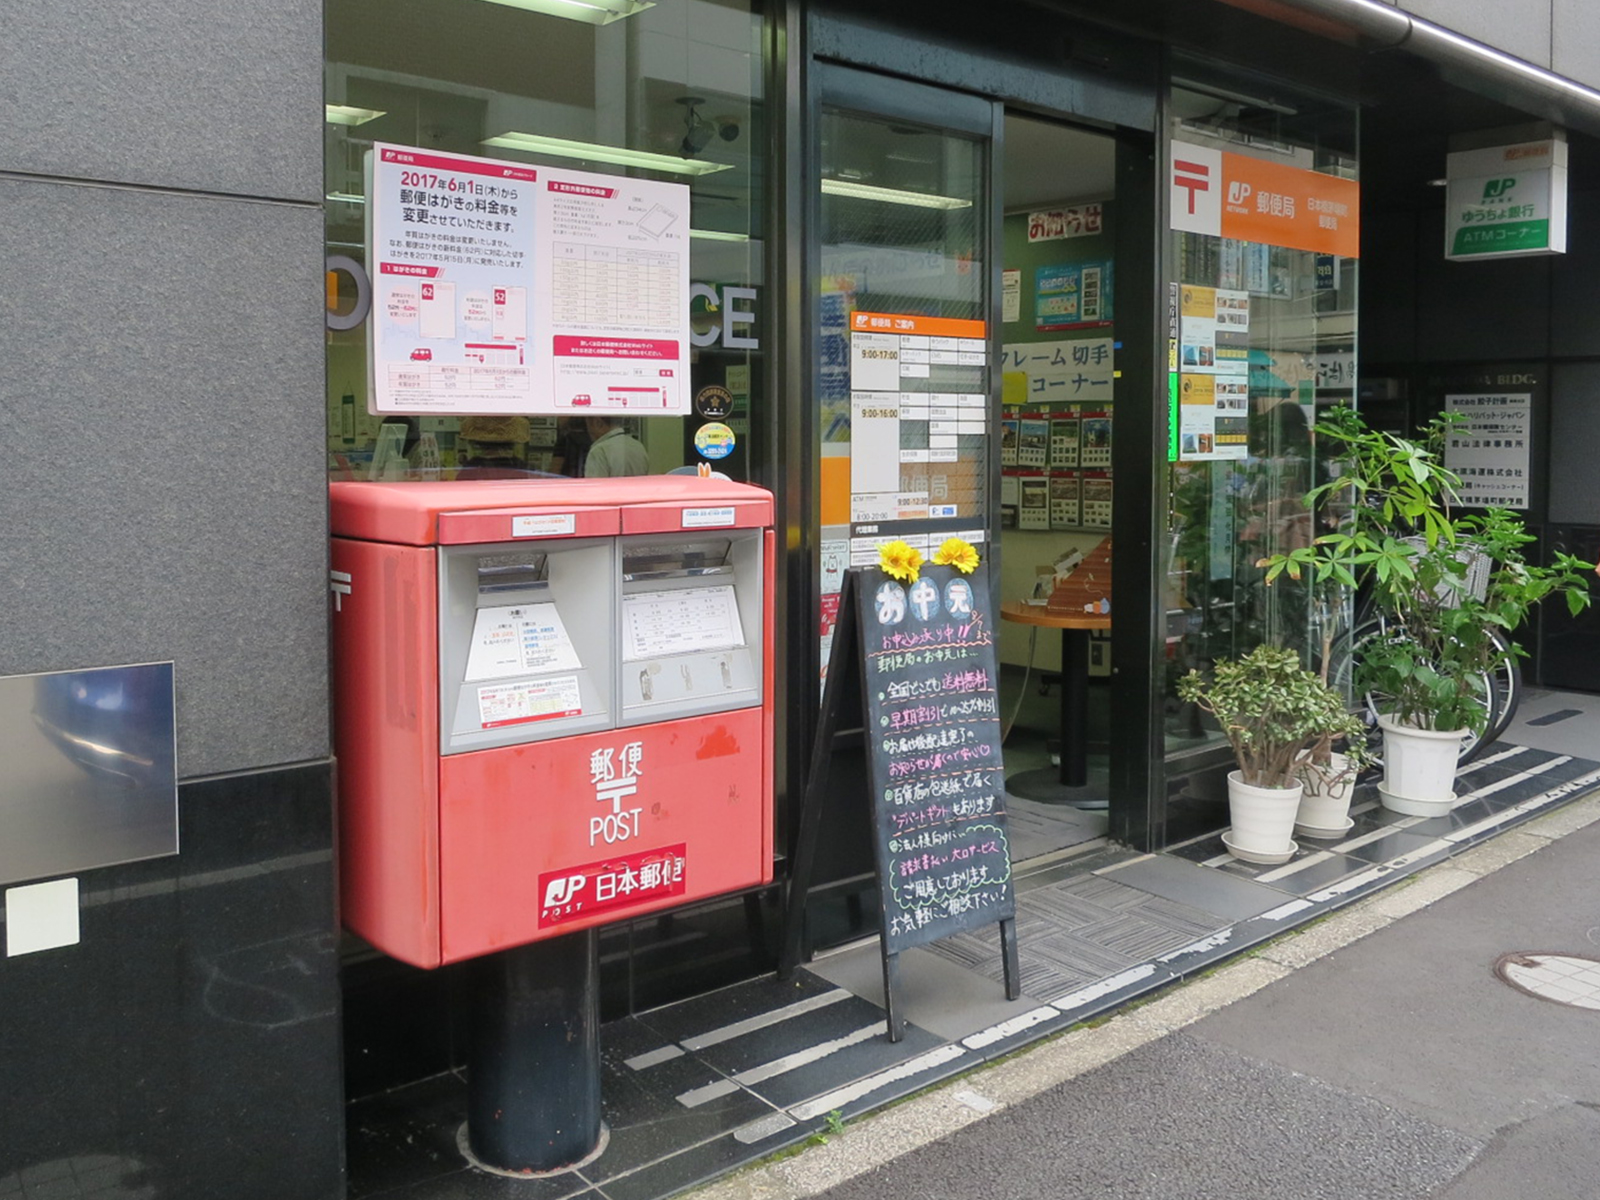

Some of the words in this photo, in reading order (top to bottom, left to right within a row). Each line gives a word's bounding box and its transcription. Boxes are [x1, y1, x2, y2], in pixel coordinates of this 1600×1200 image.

[1228, 181, 1250, 205] JP
[1483, 178, 1516, 199] JP
[400, 188, 518, 217] 郵便はがきの料金等を
[1256, 190, 1295, 219] 郵便局
[1461, 204, 1535, 223] ゆうちょ銀行
[402, 207, 515, 233] 変更させていただきます。
[1029, 205, 1102, 239] お知らせ
[1463, 227, 1541, 243] ATMコーナー
[422, 287, 433, 297] 62
[494, 292, 506, 302] 52
[895, 320, 915, 330] ご案内
[862, 350, 898, 360] 9:00-17:00
[1032, 373, 1109, 392] コーナー
[876, 581, 971, 624] お中元
[589, 741, 643, 784] 郵便
[589, 807, 643, 847] POST
[544, 874, 586, 908] JP
[596, 857, 685, 902] 日本郵便
[903, 865, 988, 899] ご用意しております
[541, 902, 583, 919] POST
